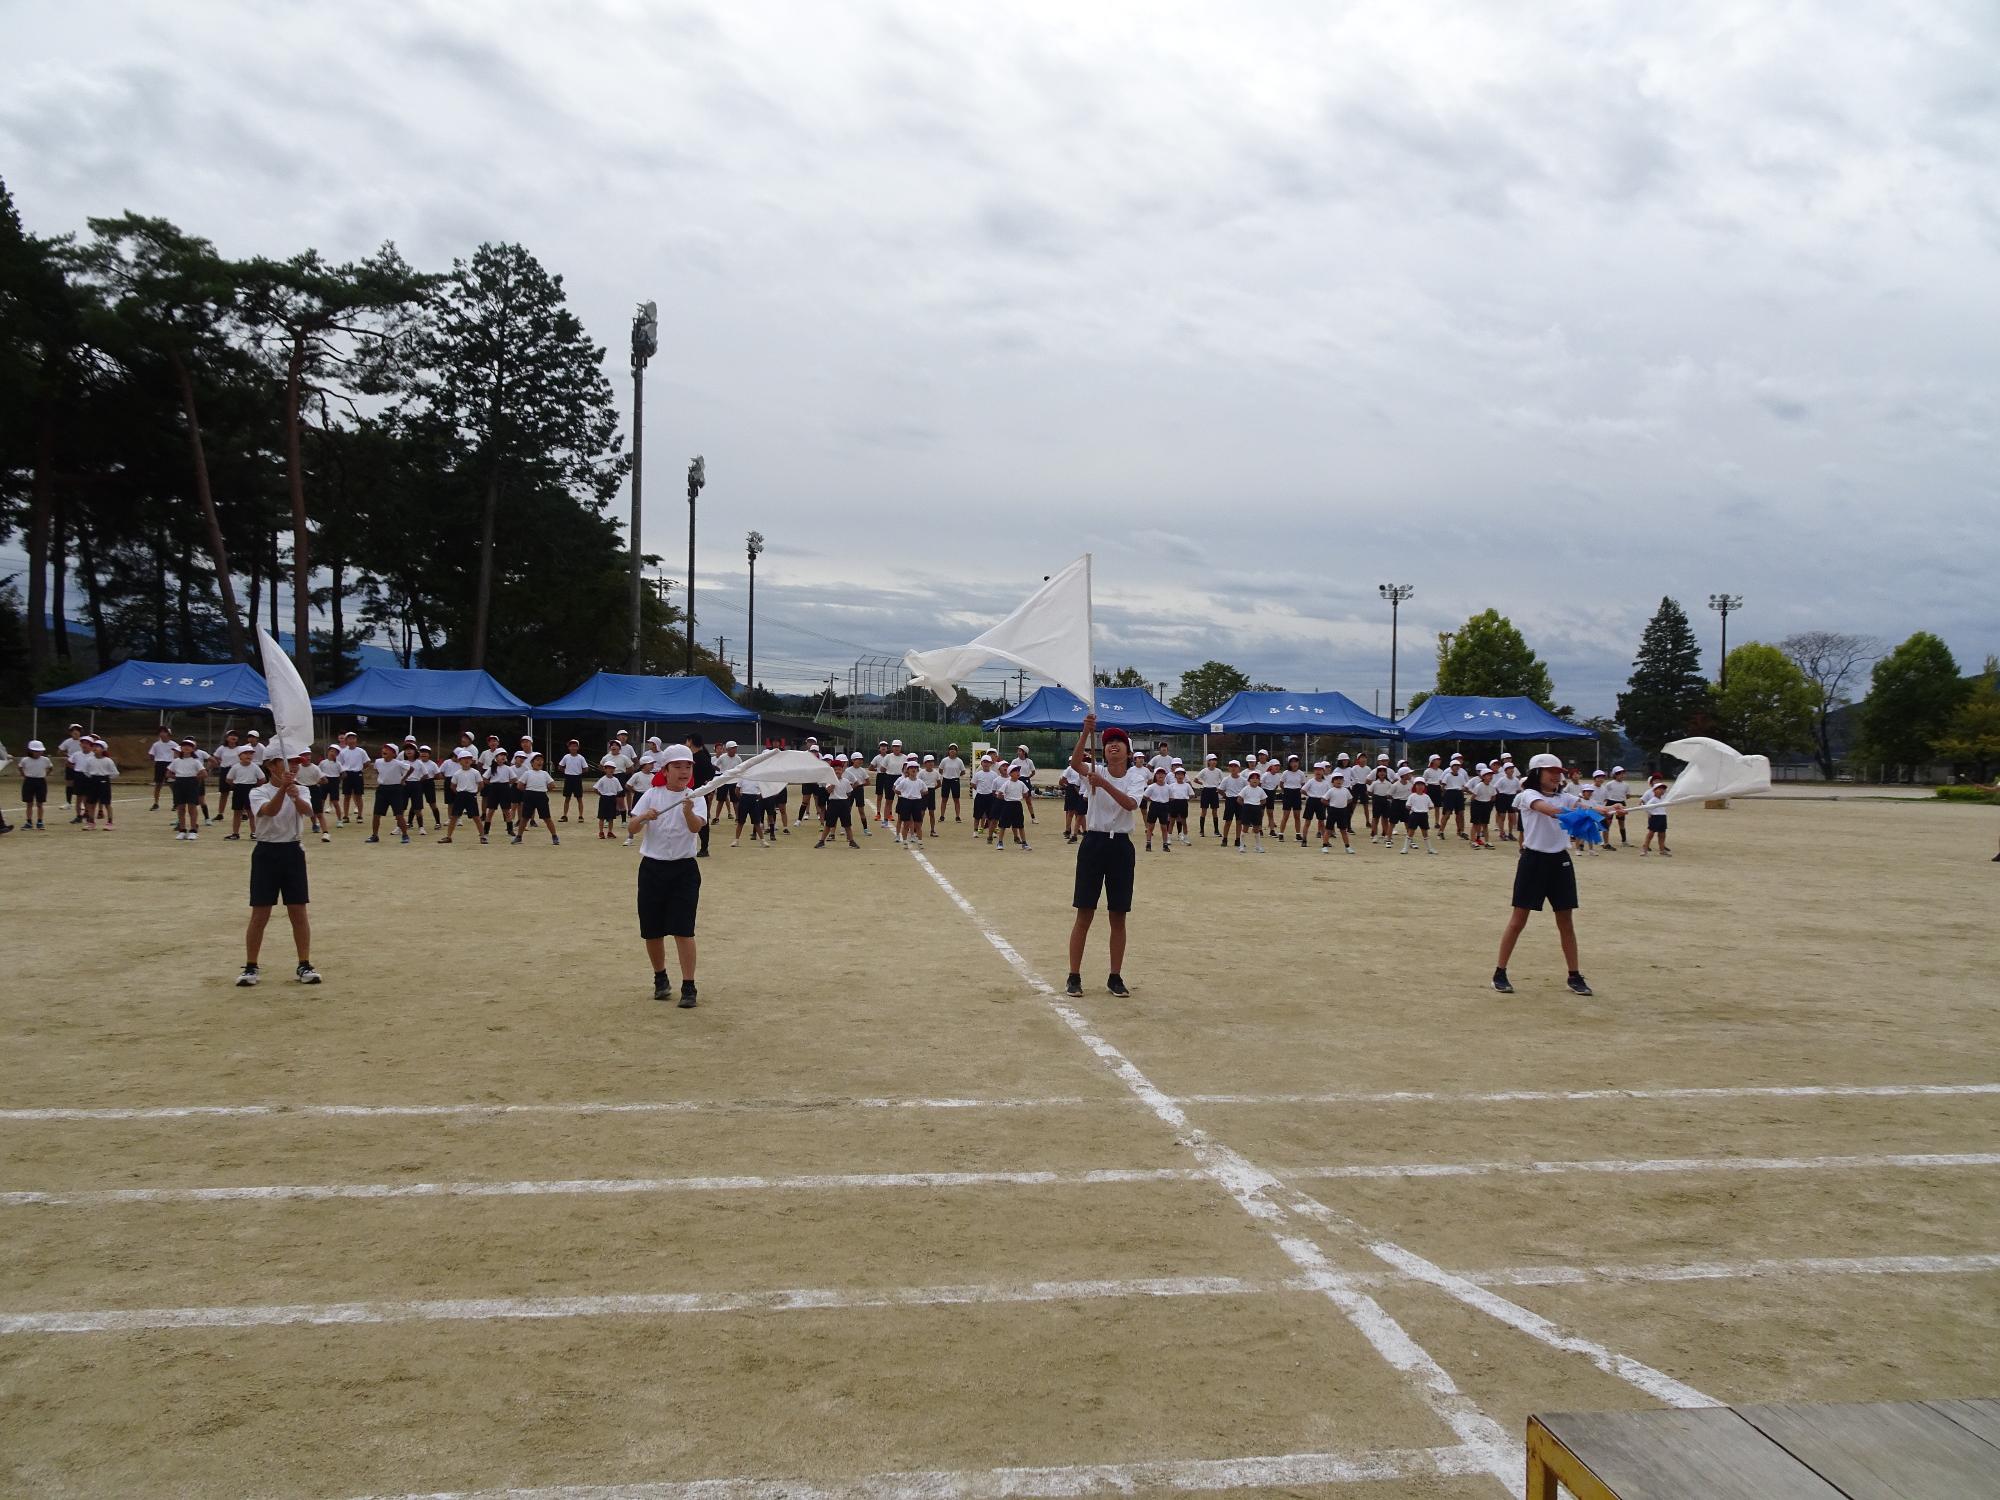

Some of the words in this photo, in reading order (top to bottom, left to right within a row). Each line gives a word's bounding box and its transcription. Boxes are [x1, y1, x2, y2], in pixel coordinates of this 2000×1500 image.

[142, 677, 214, 687] ふくおか
[1071, 702, 1124, 712] ふおか
